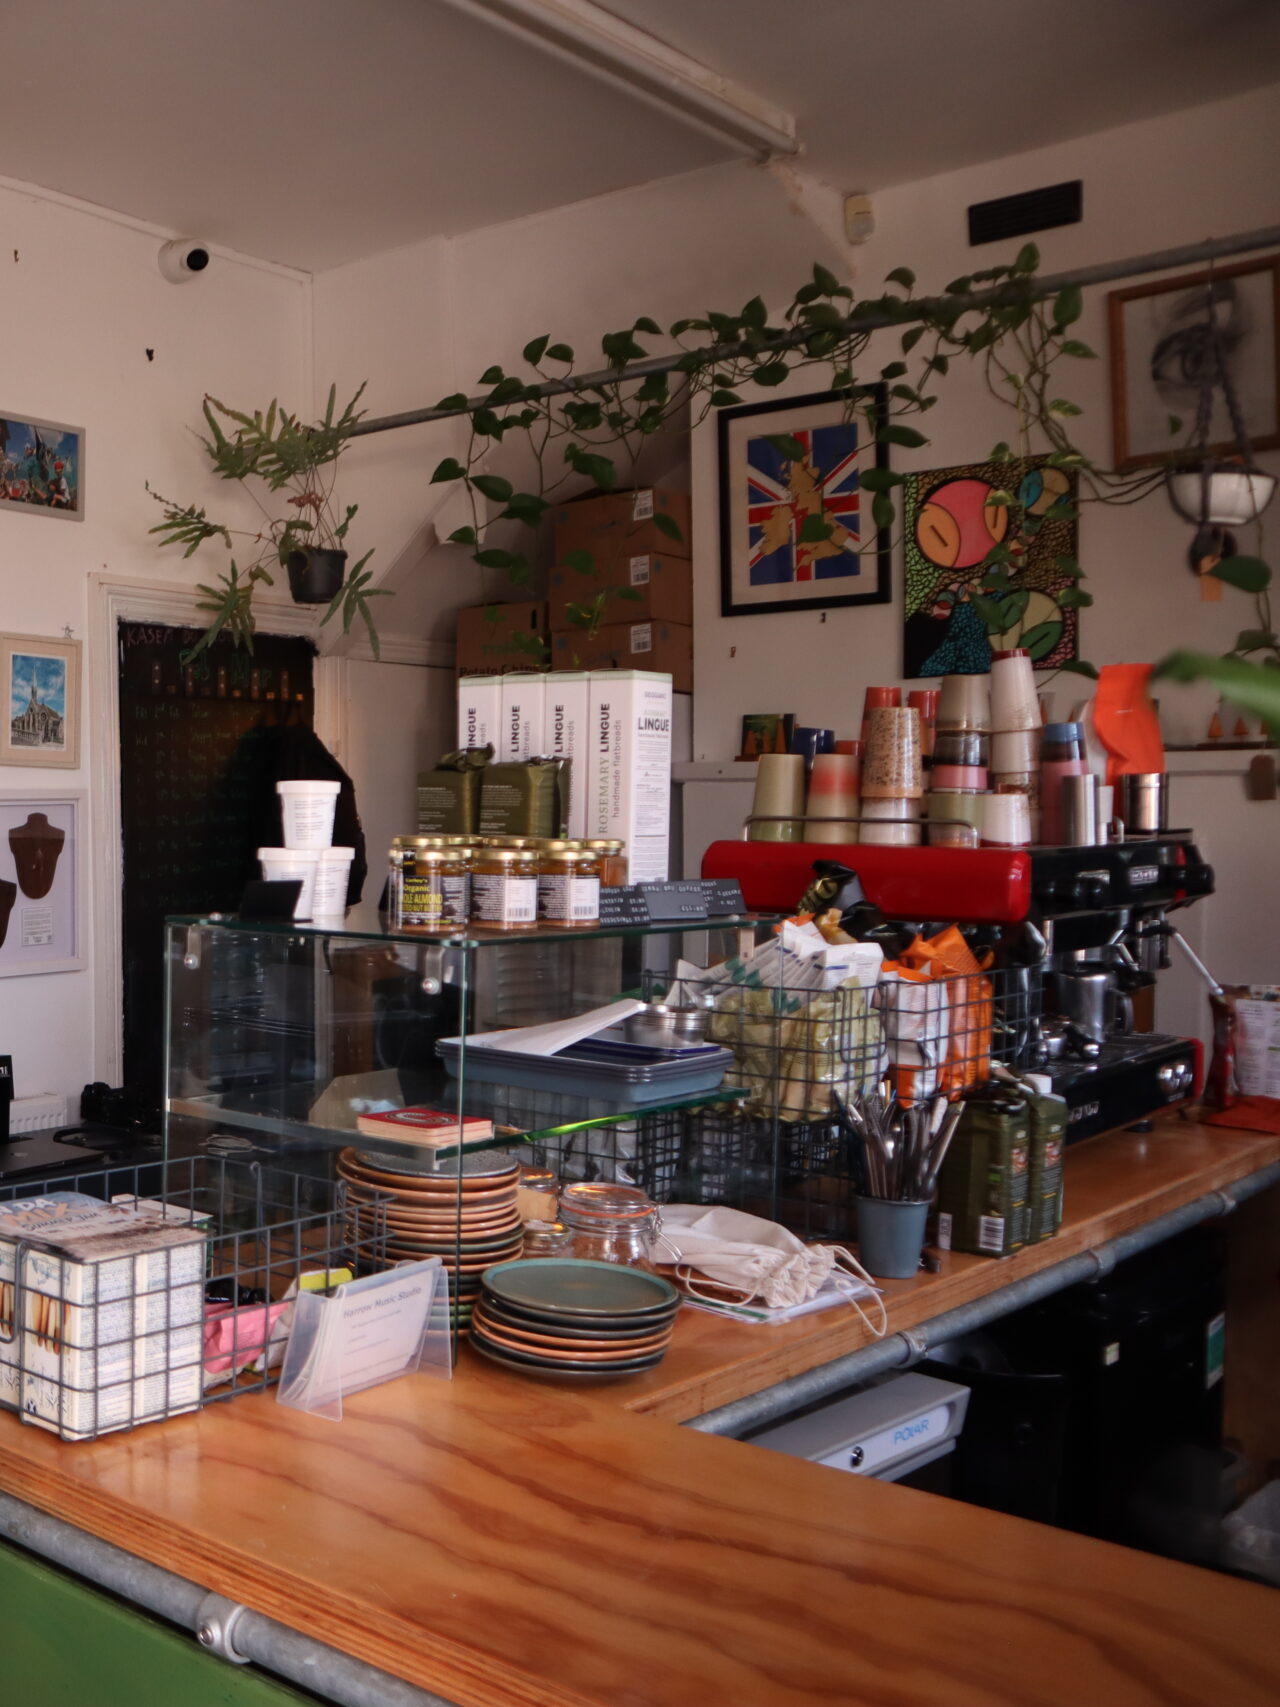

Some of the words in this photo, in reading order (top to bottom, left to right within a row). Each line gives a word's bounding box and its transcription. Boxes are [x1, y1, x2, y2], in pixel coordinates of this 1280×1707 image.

[467, 707, 477, 749] INGUE
[511, 704, 521, 753] LINGUE
[554, 704, 564, 754] LINGUE
[599, 703, 610, 753] LINGUE
[638, 717, 670, 732] LINGUE
[612, 719, 622, 769] flatbreads
[598, 758, 610, 834] ROSEMARY
[612, 770, 621, 818] handmade
[414, 893, 443, 905] ALMOND
[2, 1202, 80, 1226] MIX
[15, 1198, 57, 1211] DA
[21, 1216, 73, 1232] SUMMER
[374, 1296, 397, 1308] Music
[894, 1419, 929, 1444] POLAR
